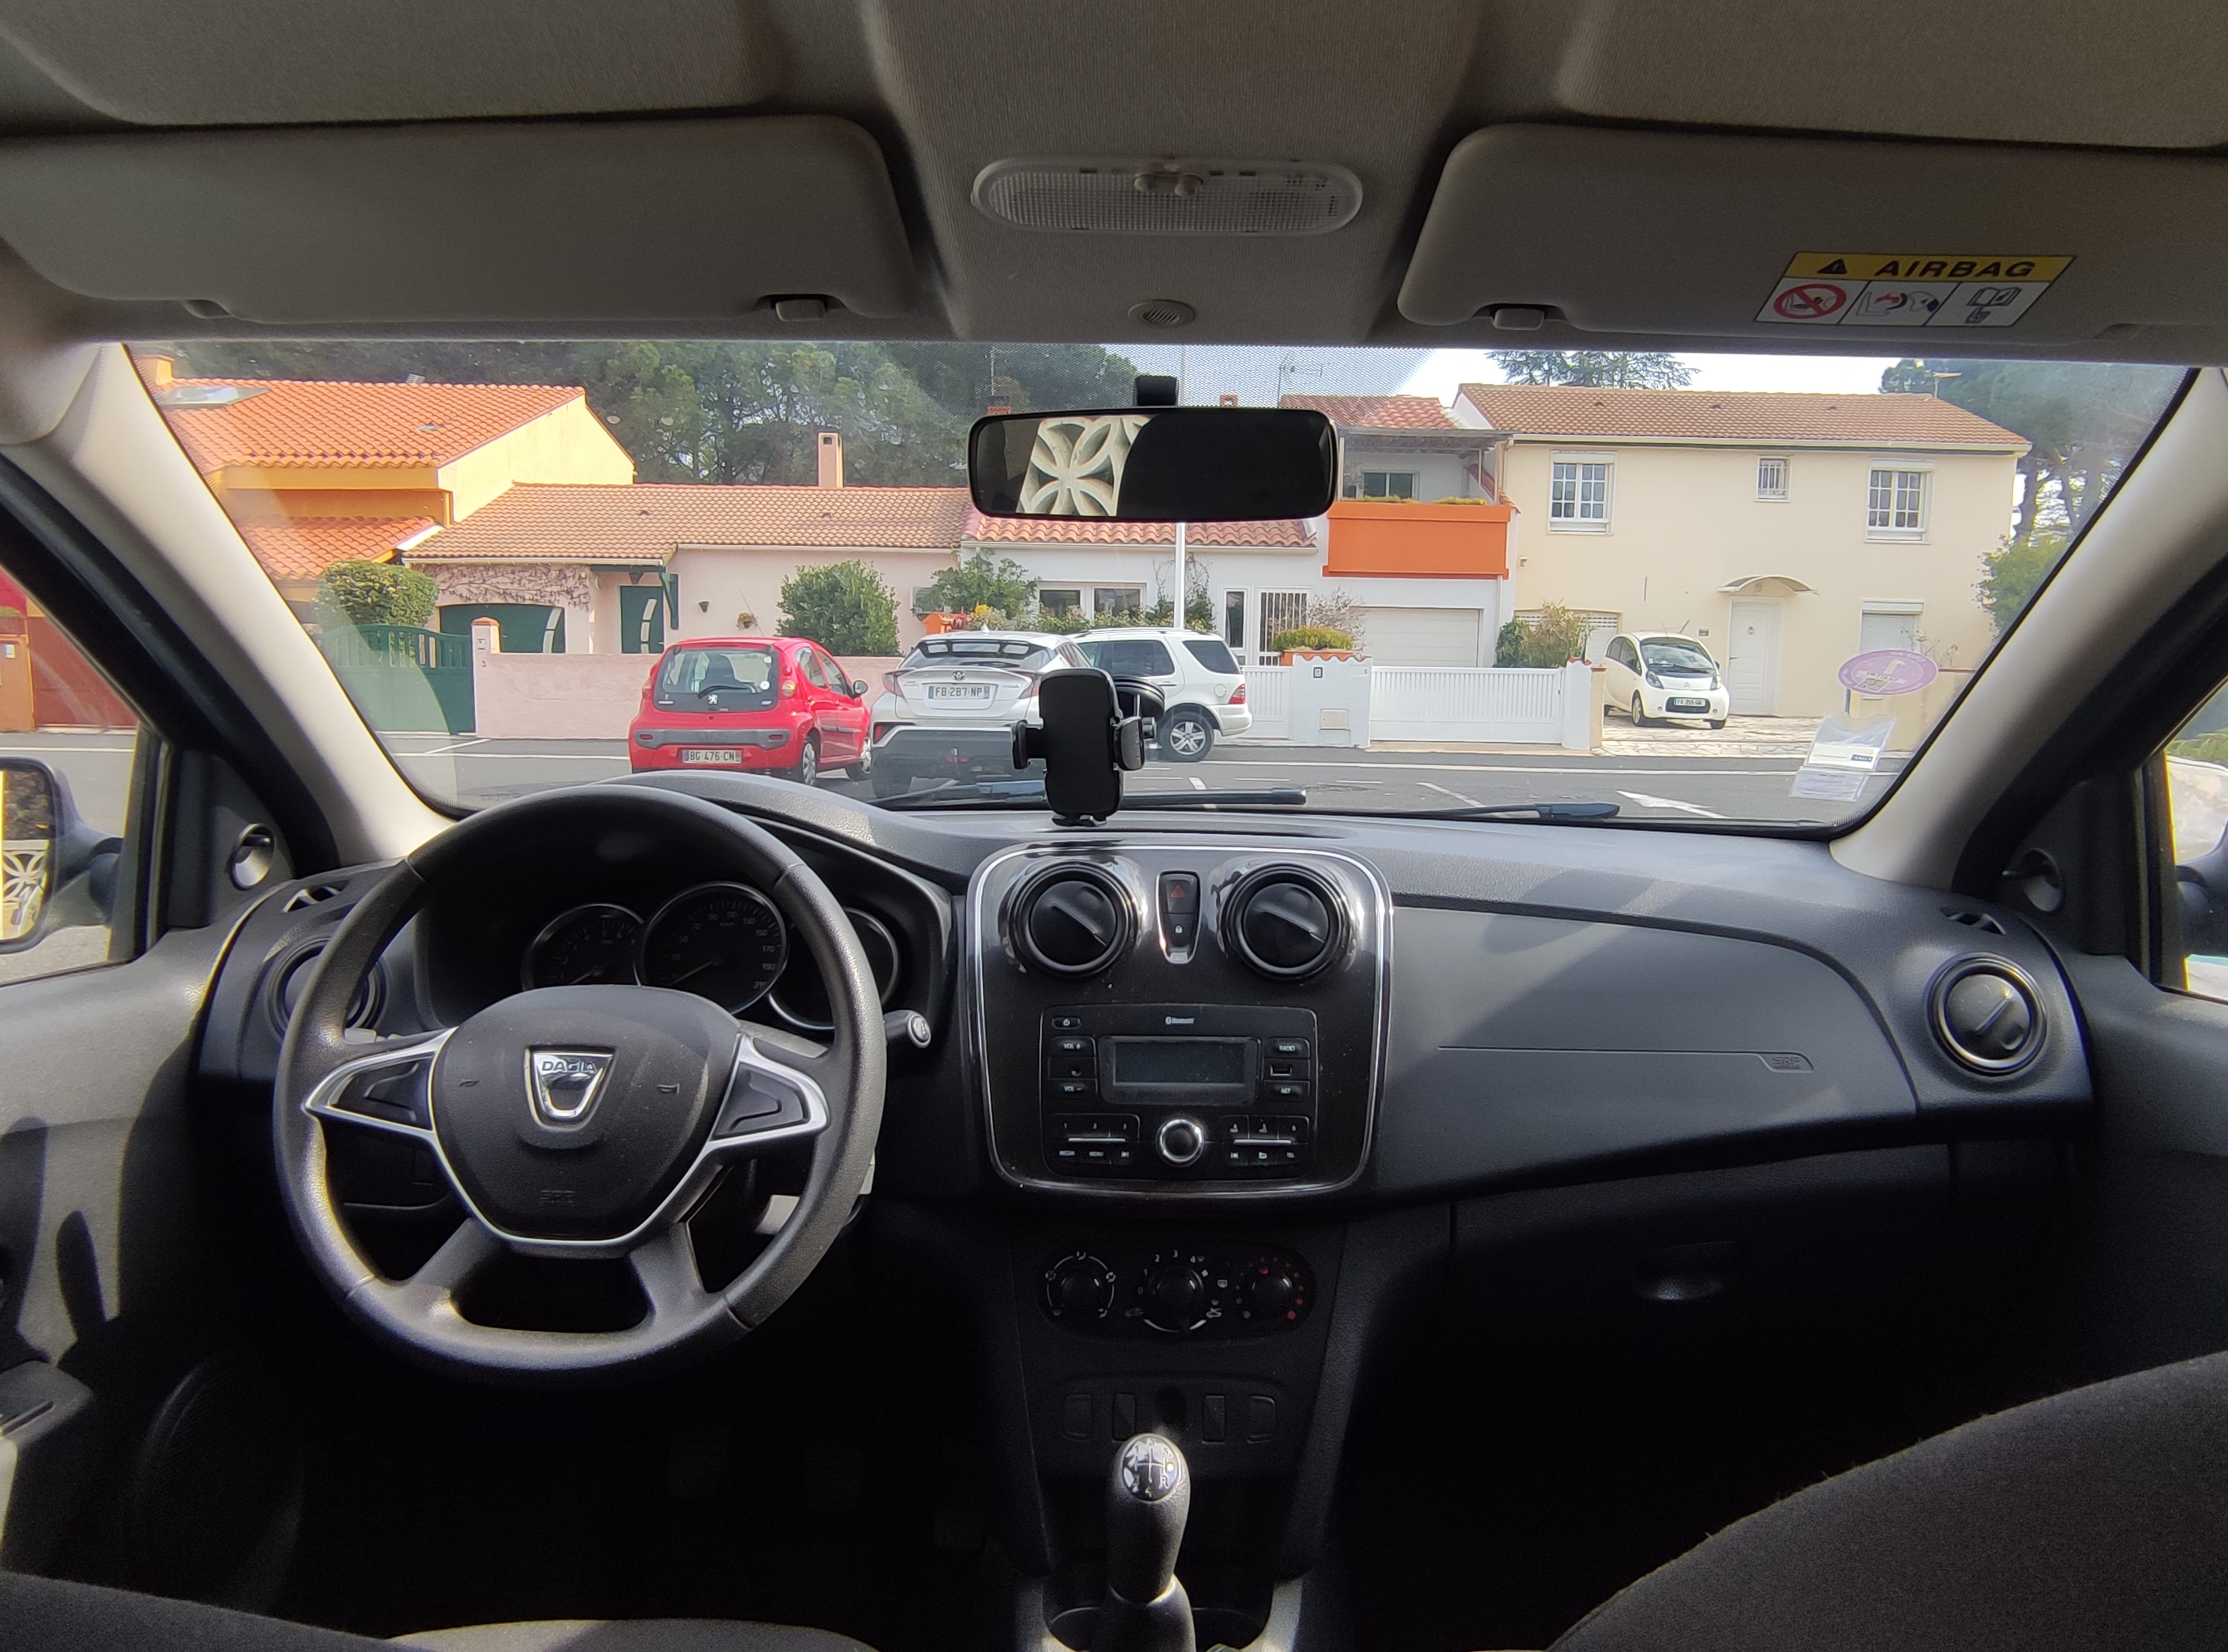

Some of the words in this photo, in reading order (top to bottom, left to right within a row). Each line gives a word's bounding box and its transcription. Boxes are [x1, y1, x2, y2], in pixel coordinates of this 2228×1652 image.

[1874, 260, 2036, 277] AIRBAG
[542, 1061, 597, 1073] DACIA
[1155, 1253, 1160, 1263] 2
[1190, 1255, 1196, 1264] 4
[1158, 1474, 1170, 1489] R
